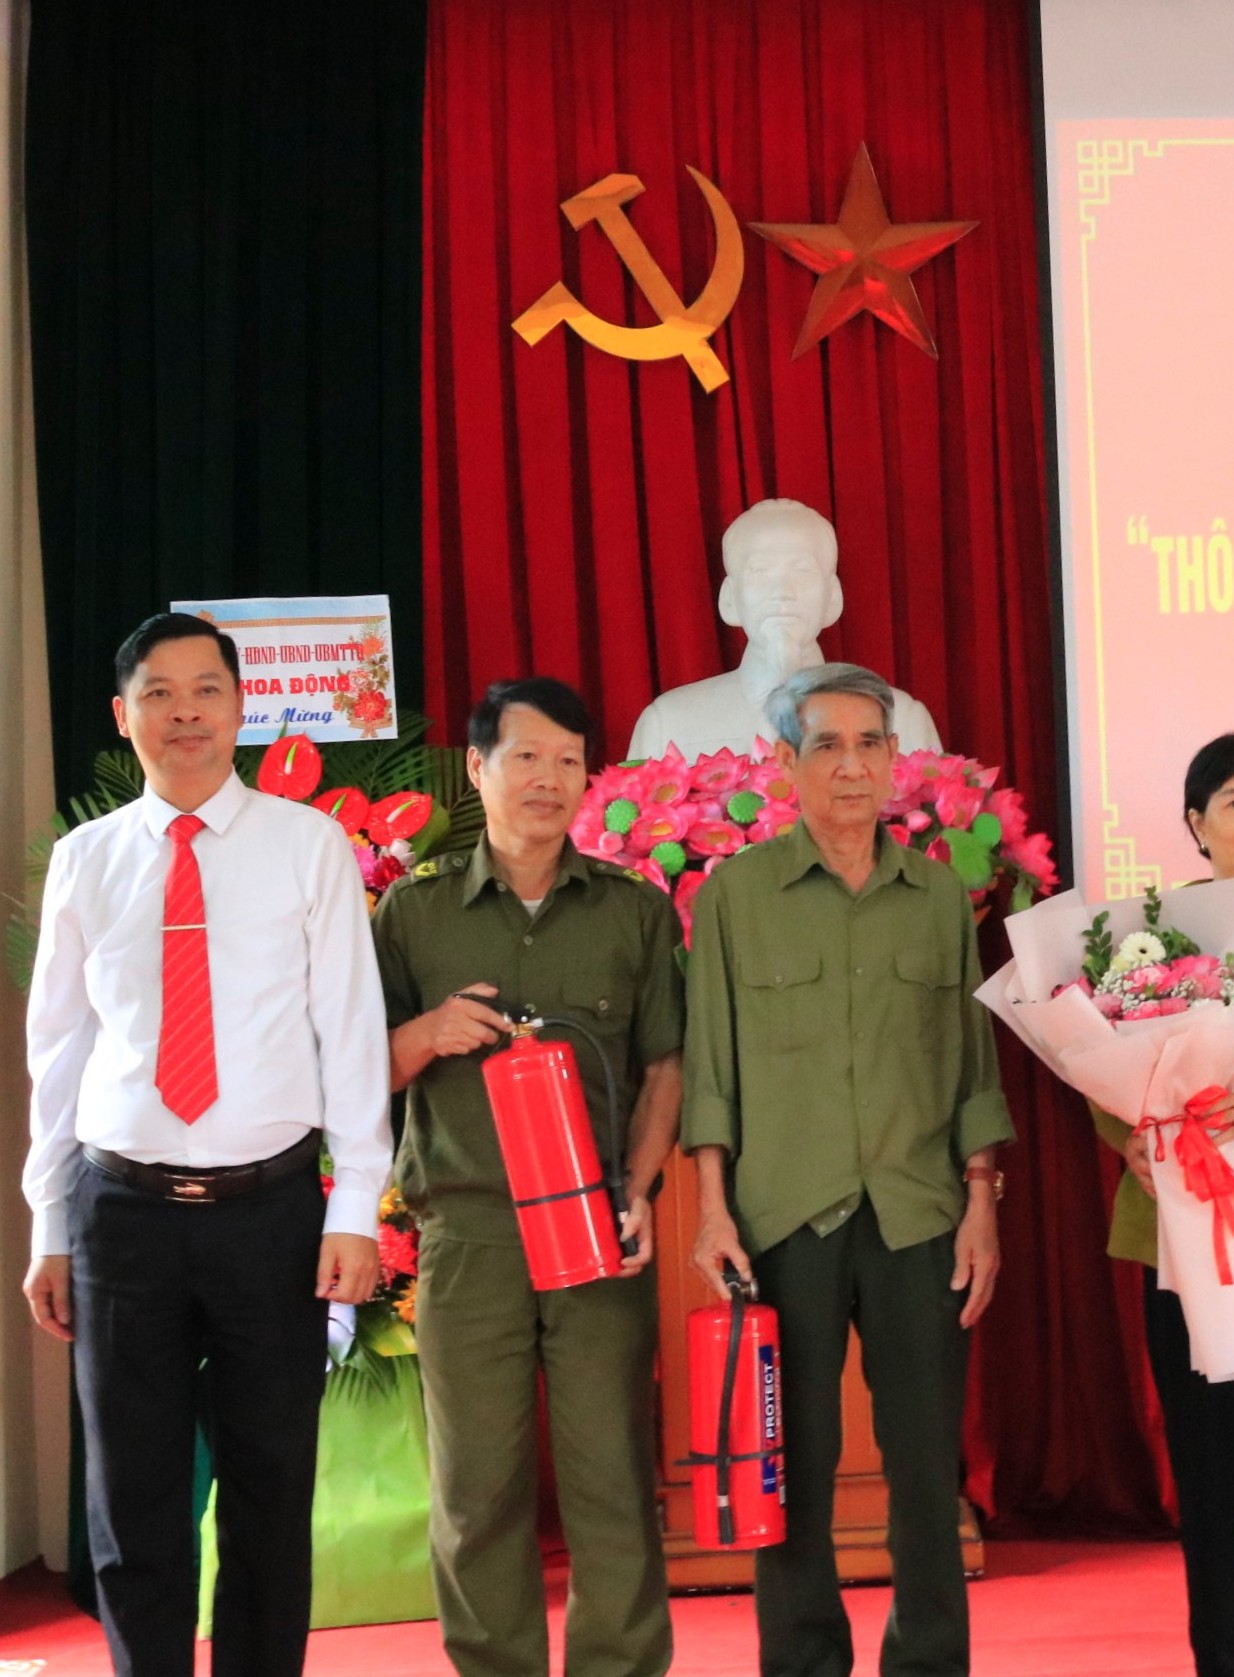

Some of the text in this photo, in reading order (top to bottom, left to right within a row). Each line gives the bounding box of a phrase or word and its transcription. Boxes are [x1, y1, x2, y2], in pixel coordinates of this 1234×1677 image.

[290, 674, 350, 696] ĐỘNG
[275, 707, 333, 724] Mừng
[764, 1363, 776, 1438] PROTECT
